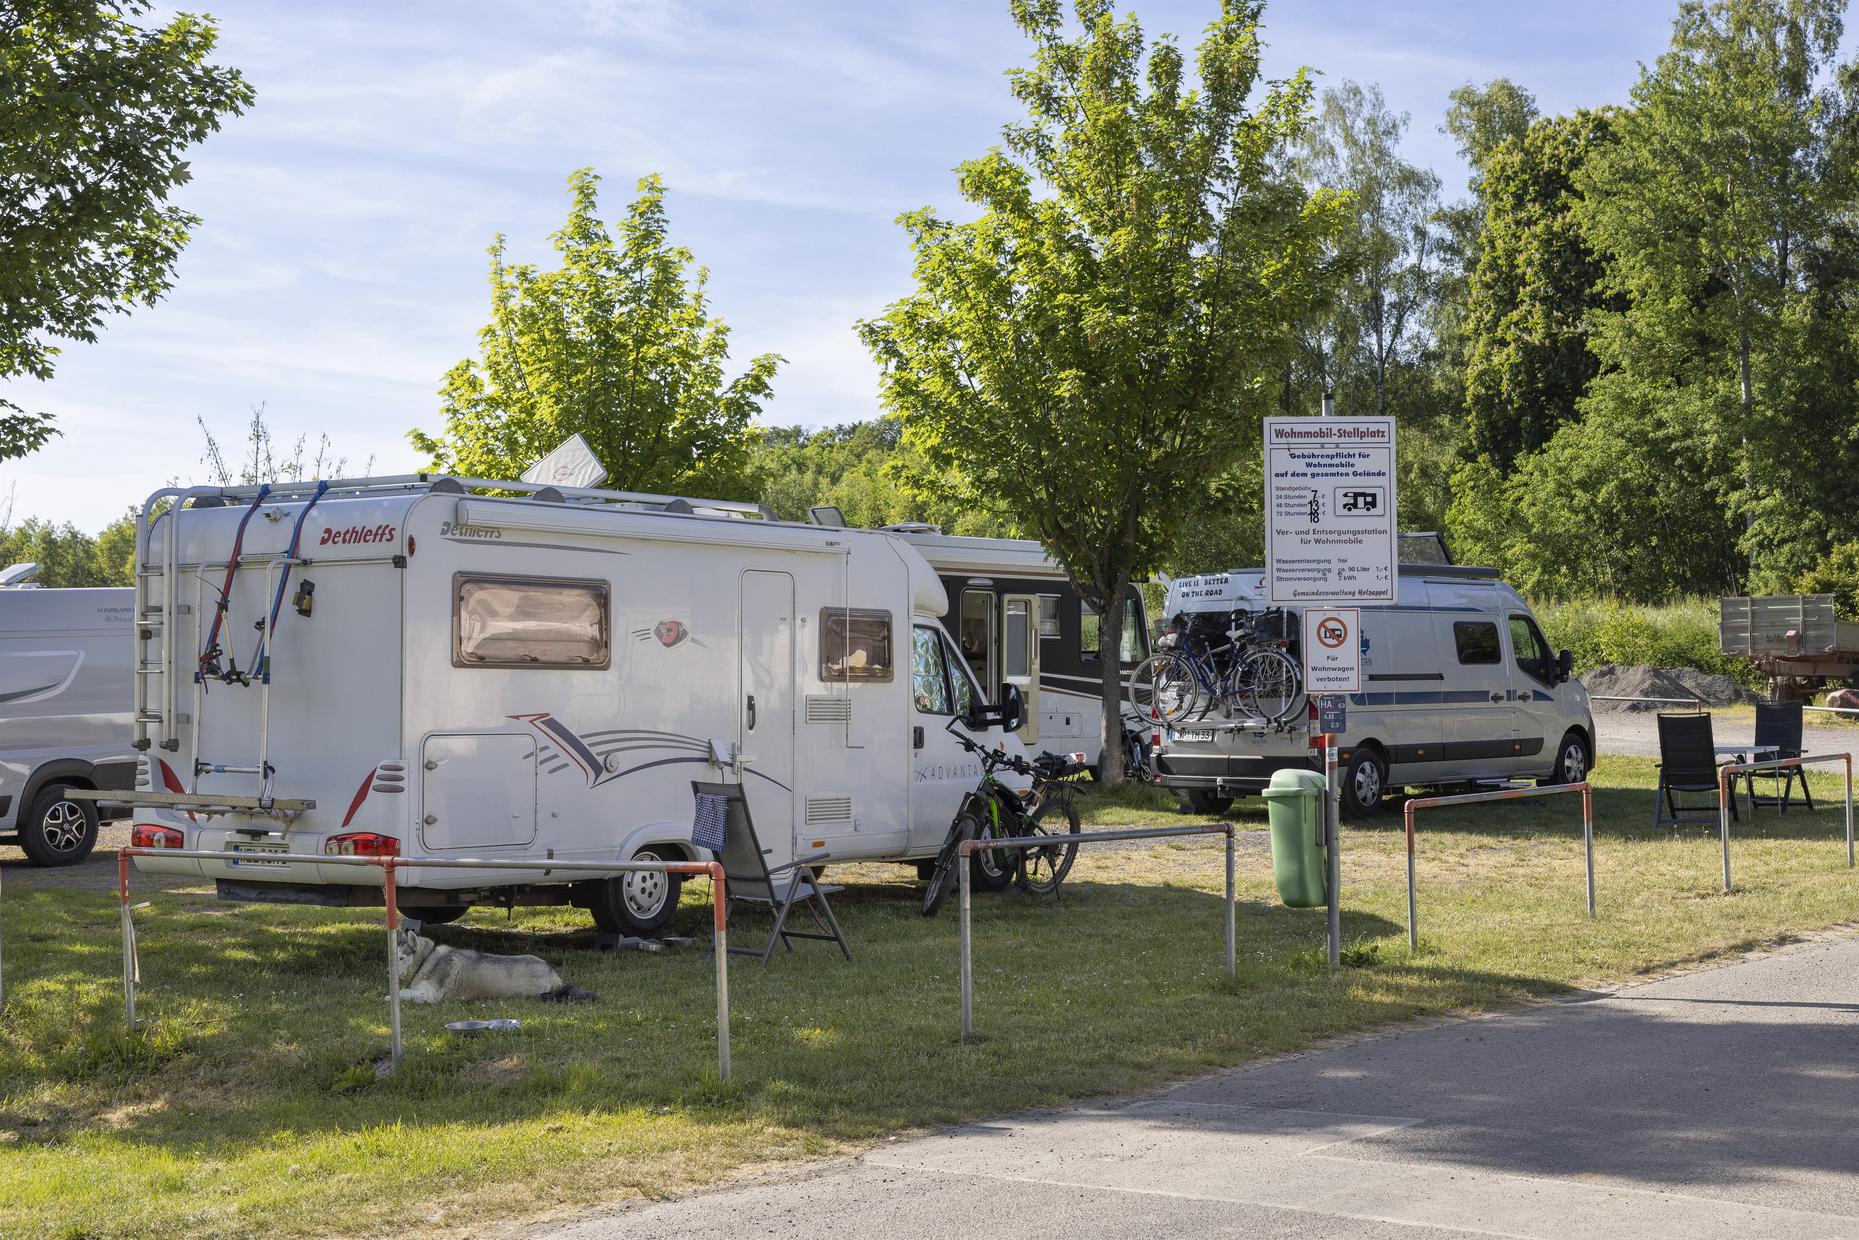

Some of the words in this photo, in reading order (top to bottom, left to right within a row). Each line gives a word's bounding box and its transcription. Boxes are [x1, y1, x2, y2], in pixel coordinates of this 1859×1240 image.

[1274, 427, 1386, 440] Wohnmobil-Stellplatz
[1290, 452, 1356, 460] Gebührenpflicht
[320, 524, 396, 545] Dethleffs
[1313, 528, 1387, 536] Entsorgungsstation
[1204, 577, 1229, 585] BETTER
[1204, 589, 1223, 597] ROAD
[1293, 589, 1356, 597] Gemeindeverwaltung
[1357, 588, 1388, 597] Holzappel
[1320, 700, 1333, 709] HA
